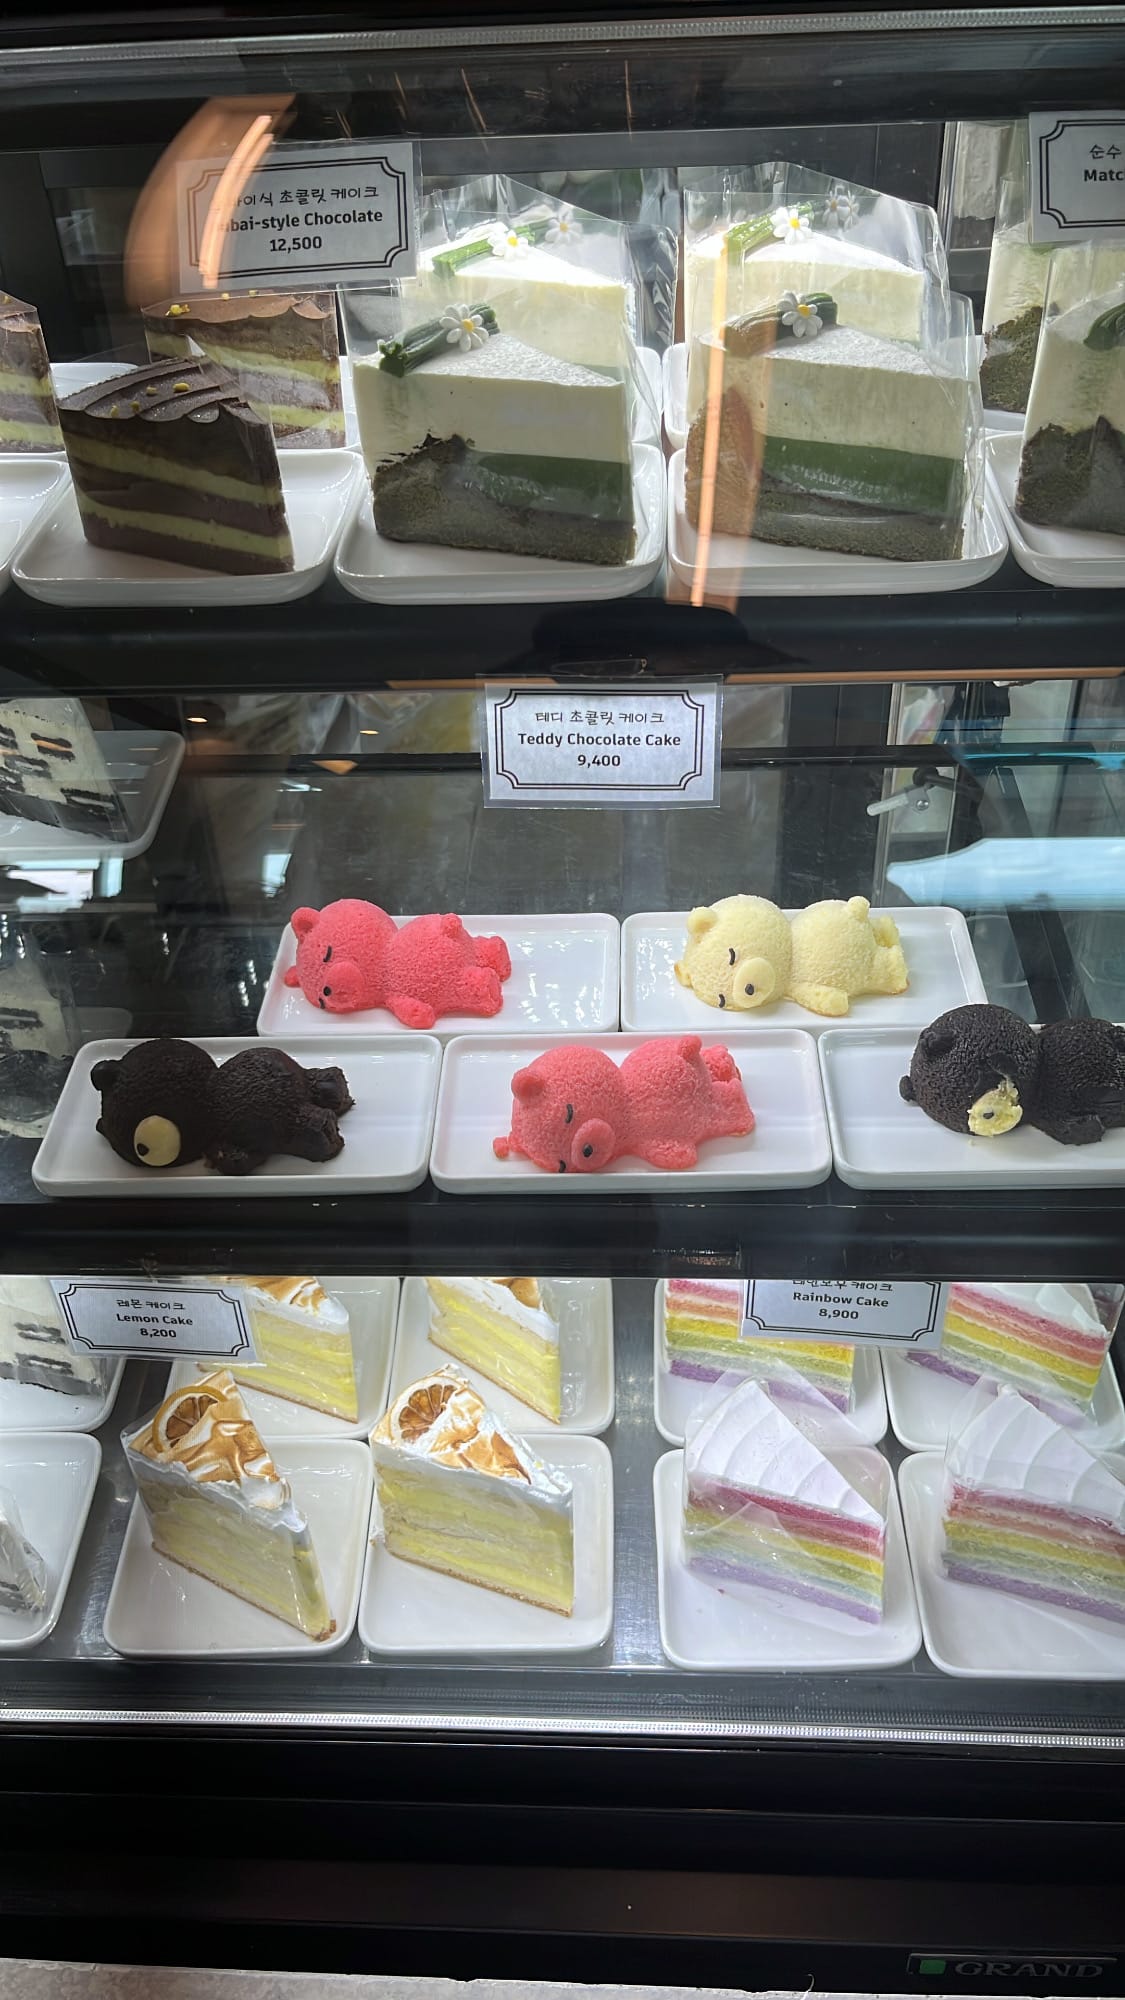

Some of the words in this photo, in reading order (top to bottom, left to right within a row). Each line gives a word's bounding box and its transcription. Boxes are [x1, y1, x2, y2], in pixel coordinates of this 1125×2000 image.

[1089, 144, 1122, 160] 순수
[1083, 169, 1125, 182] Matc
[280, 187, 327, 206] 초콜릿
[331, 186, 379, 199] 케이크
[304, 210, 383, 226] Chocolate
[270, 236, 323, 254] 12,500
[535, 711, 563, 723] 테디
[569, 710, 615, 726] 초콜릿
[618, 712, 665, 724] 케이크
[517, 733, 563, 748] Teddy
[567, 733, 641, 746] Chocolate
[645, 734, 681, 746] Cake
[577, 754, 621, 769] 9,400
[850, 1281, 893, 1292] 케이크
[116, 1299, 142, 1309] 레몬
[145, 1300, 186, 1310] 케이크
[793, 1292, 852, 1305] Rainbow
[856, 1296, 889, 1308] Cake
[116, 1313, 159, 1323] Lemon
[162, 1315, 193, 1326] Cake
[818, 1308, 859, 1320] 8,900
[140, 1327, 177, 1338] 8,200
[954, 1961, 1104, 1978] GRAND
